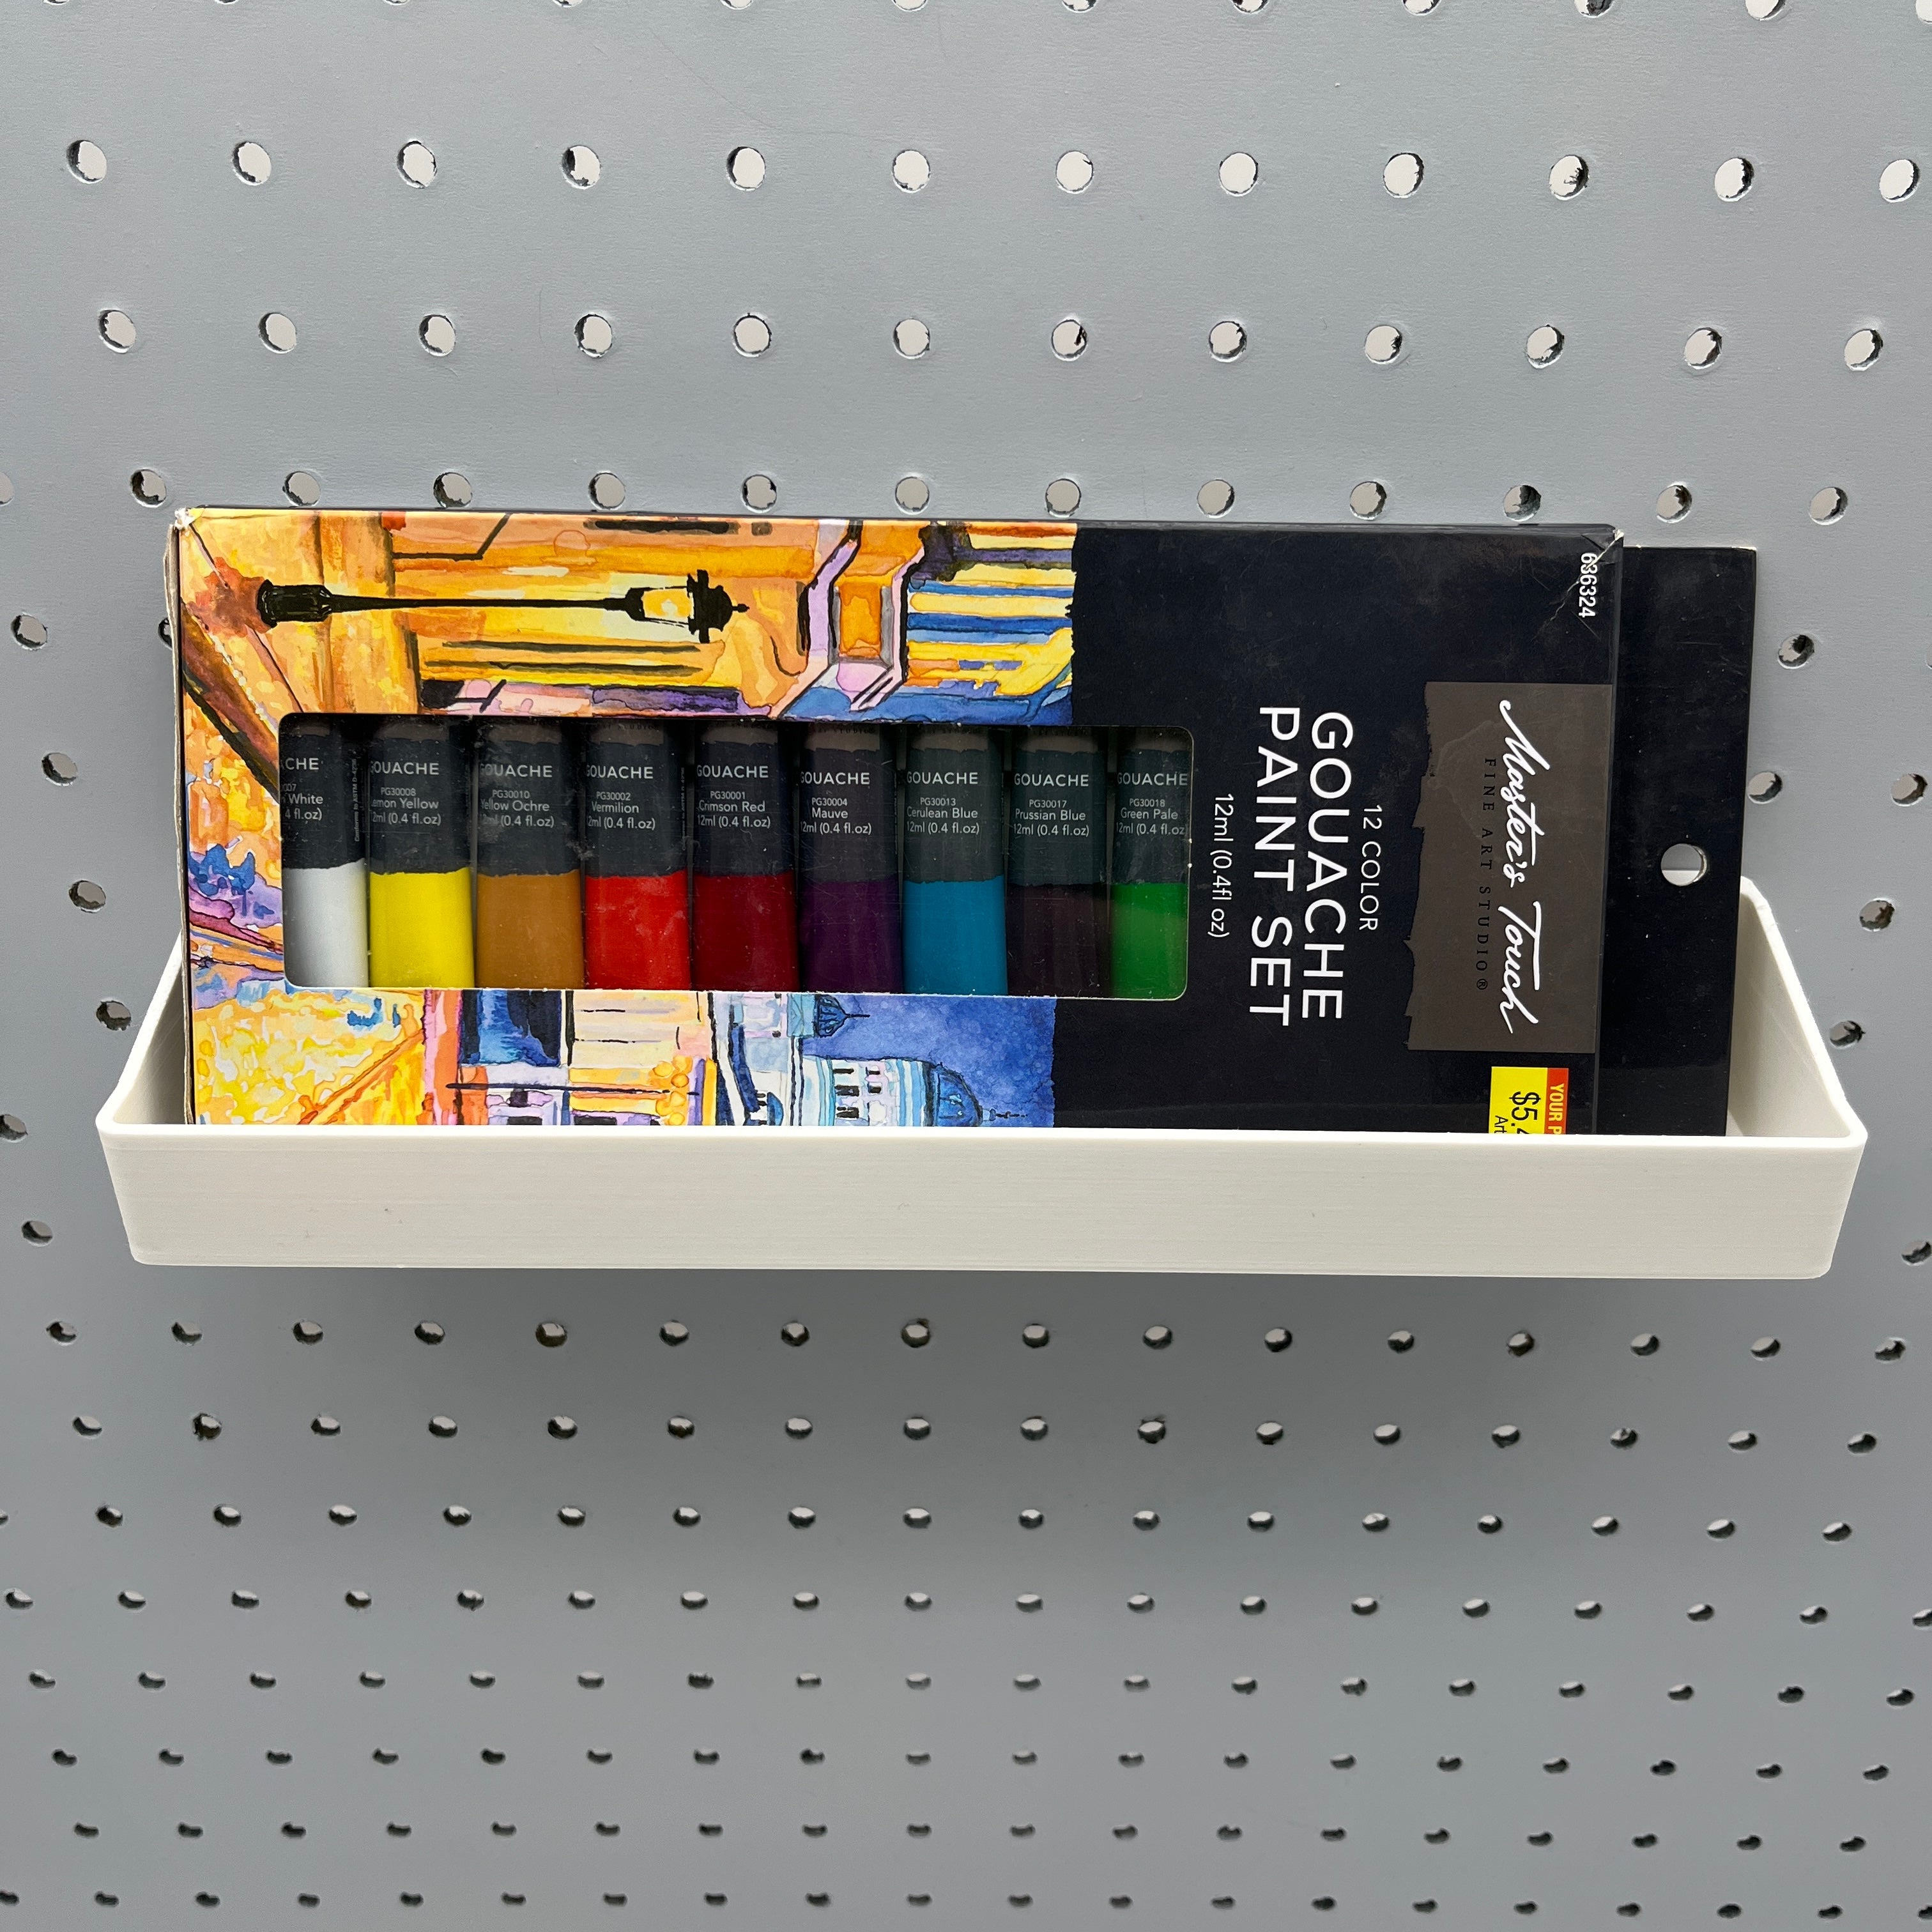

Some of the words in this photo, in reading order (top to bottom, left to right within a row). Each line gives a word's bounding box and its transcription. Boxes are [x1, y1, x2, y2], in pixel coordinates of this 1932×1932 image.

[1578, 553, 1598, 618] 636324
[696, 765, 769, 778] GOUACHE
[906, 771, 979, 785] GOUACHE
[1014, 773, 1089, 787] GOUACHE
[1482, 758, 1497, 811] FINE
[288, 793, 323, 805] White
[492, 789, 531, 799] PG30010
[596, 791, 631, 801] PG30002
[710, 791, 746, 800] PG30001
[1254, 707, 1300, 892] PAINT
[1499, 700, 1550, 888] Master's
[371, 799, 396, 808] emon
[399, 797, 439, 809] Yellow
[512, 800, 550, 811] Ochre
[591, 801, 640, 813] Vermilion
[698, 800, 738, 812] Crimson
[742, 801, 765, 813] Red
[811, 797, 848, 806] PG30004
[919, 797, 956, 806] PG30013
[1029, 799, 1067, 808] PG30017
[1129, 798, 1165, 808] PG30018
[388, 813, 408, 825] (0.4
[412, 812, 441, 826] fl.oz)
[811, 807, 848, 818] Mauve
[906, 806, 948, 819] Cerulean
[952, 807, 978, 819] Blue
[1015, 808, 1056, 821] Prussian
[1060, 809, 1086, 821] Blue
[1121, 807, 1149, 819] Green
[1153, 808, 1179, 820] Pale
[1213, 793, 1234, 841] 12ml
[1363, 804, 1383, 829] 12
[501, 815, 521, 827] (0.4
[525, 815, 555, 829] fl.oz)
[603, 816, 624, 830] (0.4
[627, 816, 656, 831] fl.oz)
[697, 815, 716, 827] 12ml
[718, 816, 739, 829] (0.4
[742, 815, 771, 829] fl.oz)
[820, 822, 840, 836] (0.4
[843, 822, 872, 836] fl.oz)
[906, 820, 926, 833] 12ml
[928, 822, 949, 835] (0.4
[952, 822, 980, 836] fl.oz)
[1013, 823, 1034, 836] 12ml
[1037, 824, 1059, 837] (0.4
[1062, 824, 1090, 838] fl.oz)
[1137, 823, 1157, 836] (0.4
[1480, 827, 1494, 870] ART
[1301, 712, 1354, 1020] GOUACHE
[1209, 850, 1232, 900] (0.4fl
[1359, 841, 1381, 930] COLOR
[1208, 908, 1230, 938] oz)
[1249, 916, 1293, 1027] SET
[1498, 901, 1542, 1034] Touch
[1548, 1083, 1565, 1121] YOUR
